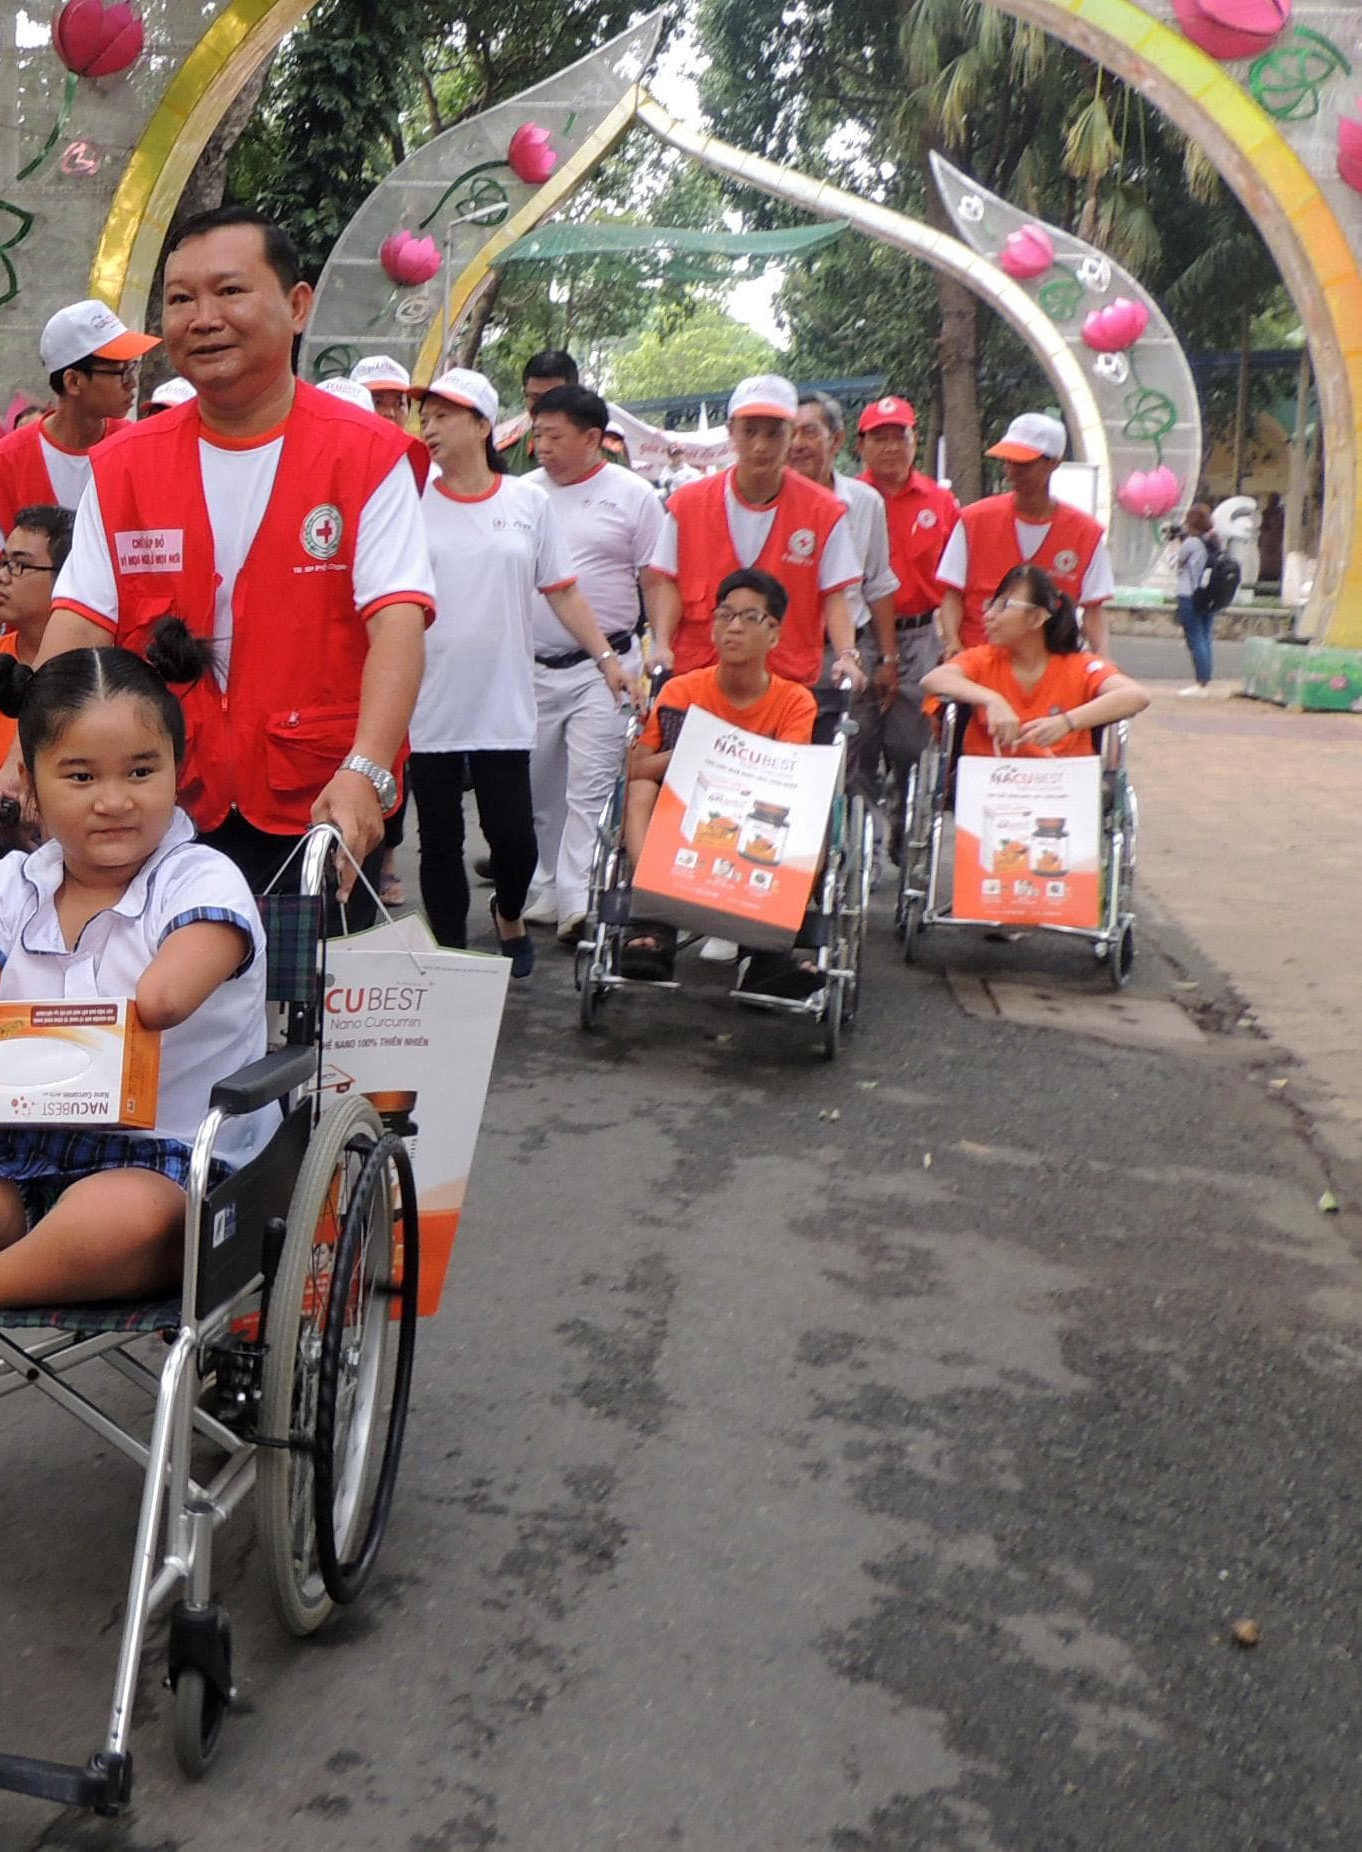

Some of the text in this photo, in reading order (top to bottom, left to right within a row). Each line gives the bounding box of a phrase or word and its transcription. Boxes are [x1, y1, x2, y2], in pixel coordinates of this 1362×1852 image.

[330, 1016, 422, 1030] Nano Curcumin
[41, 1101, 109, 1116] NACUBEST
